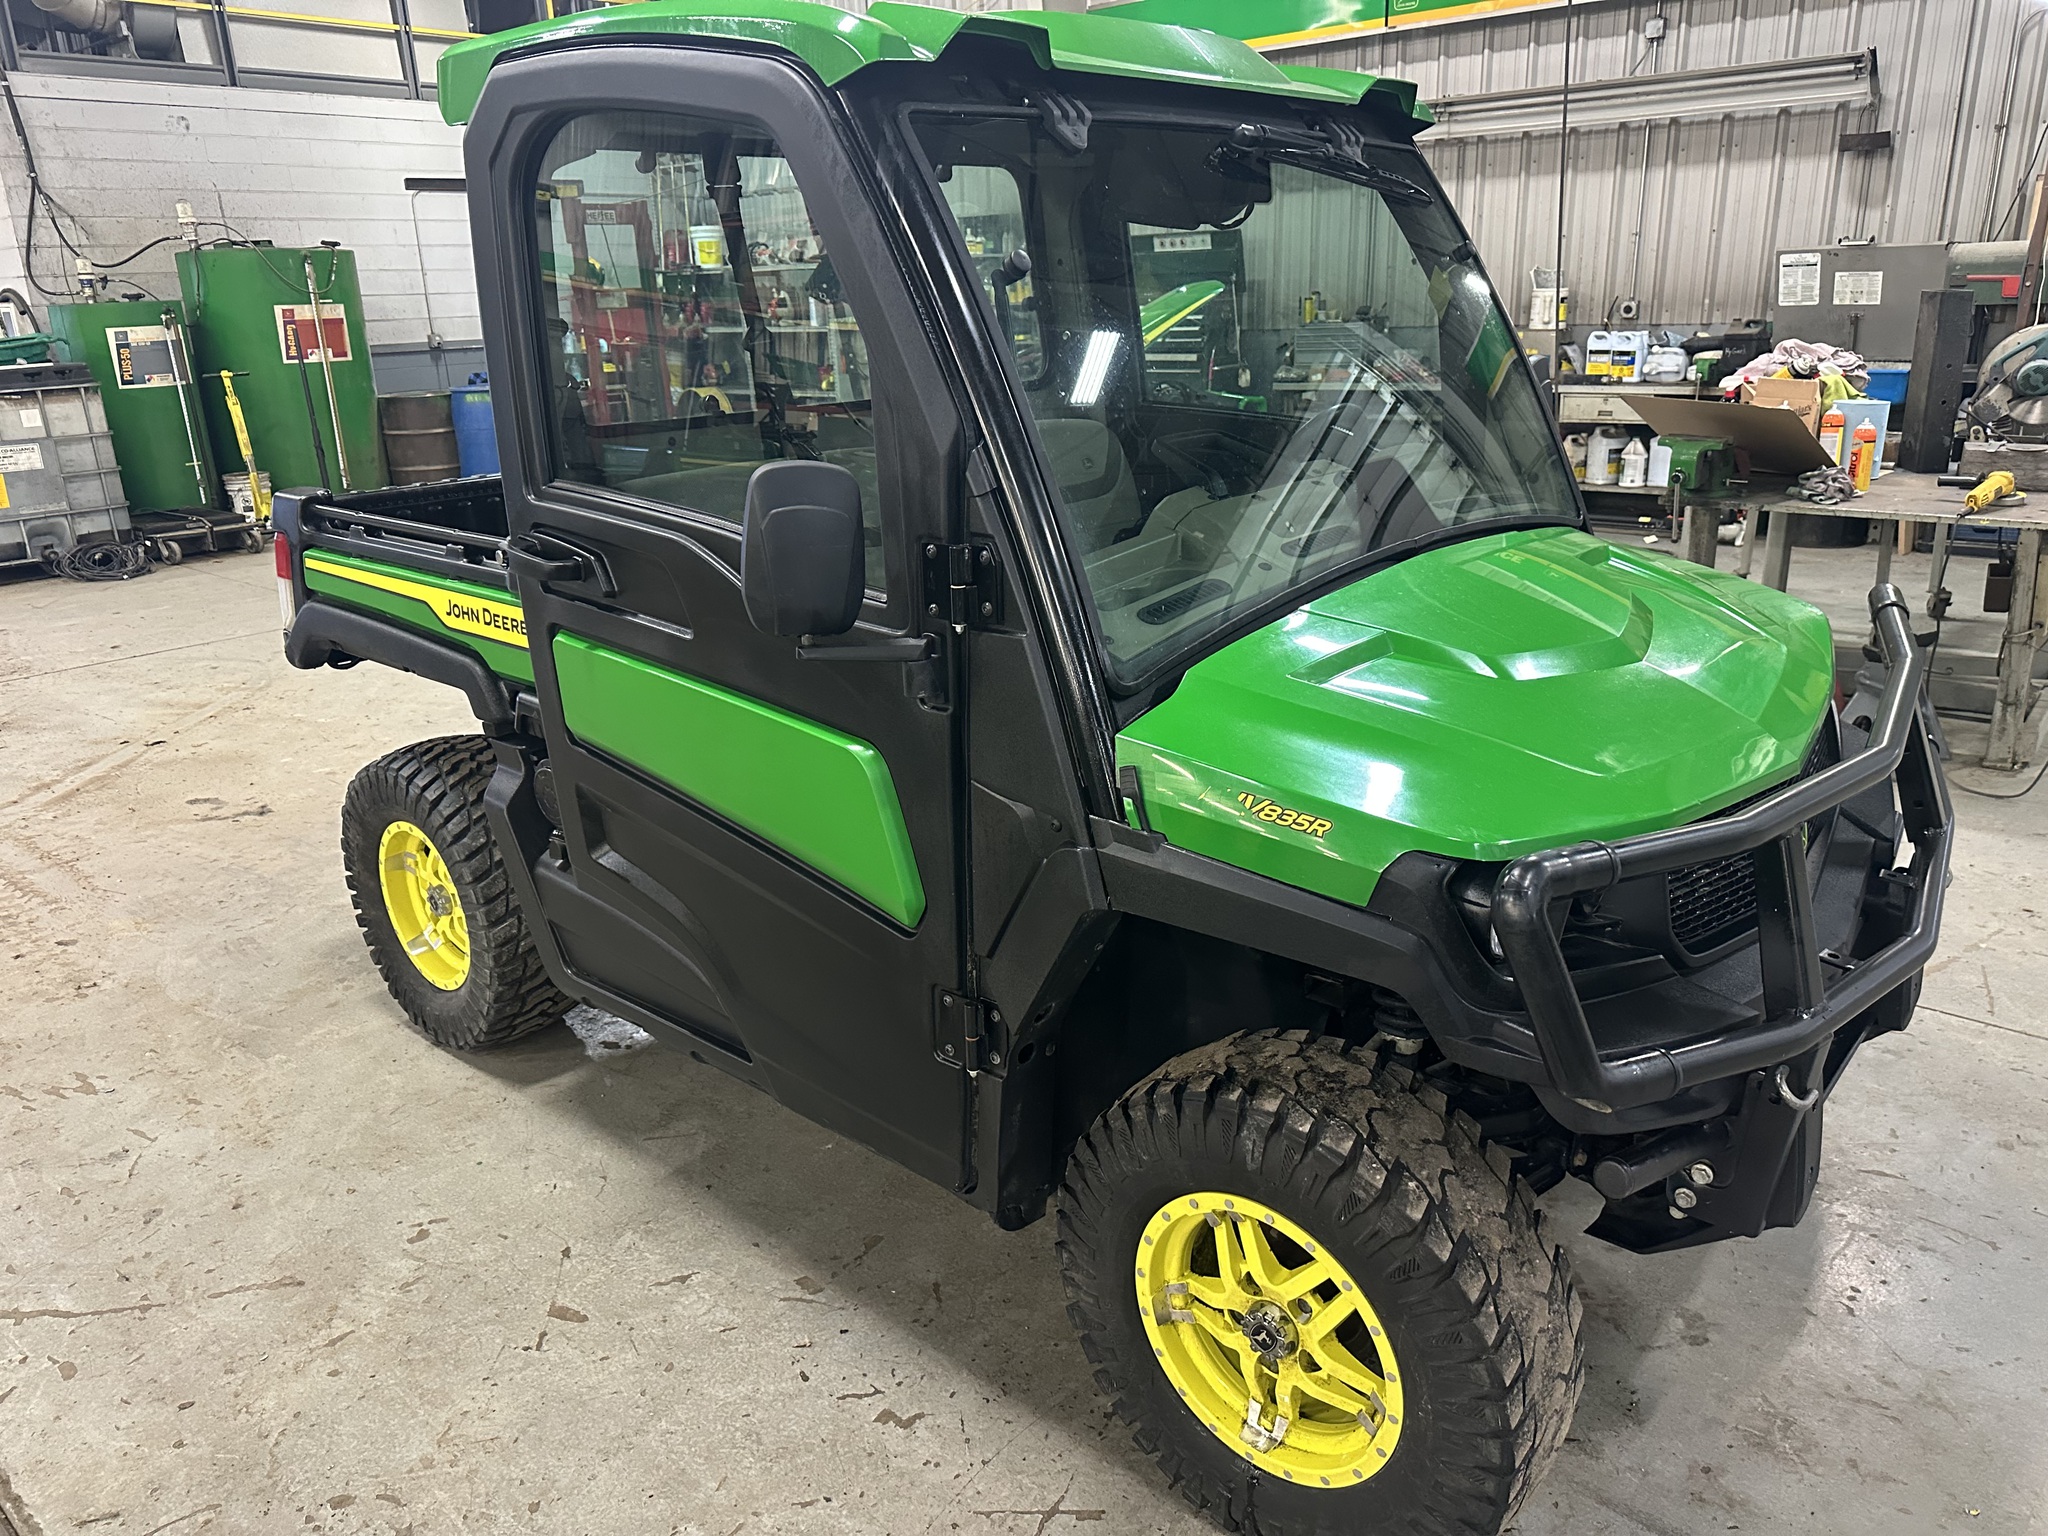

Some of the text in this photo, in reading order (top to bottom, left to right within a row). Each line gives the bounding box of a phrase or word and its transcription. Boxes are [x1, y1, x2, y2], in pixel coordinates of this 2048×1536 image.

[120, 348, 134, 381] PLUS-50
[446, 599, 528, 636] JOHN DEERE
[1237, 791, 1334, 838] V835R
